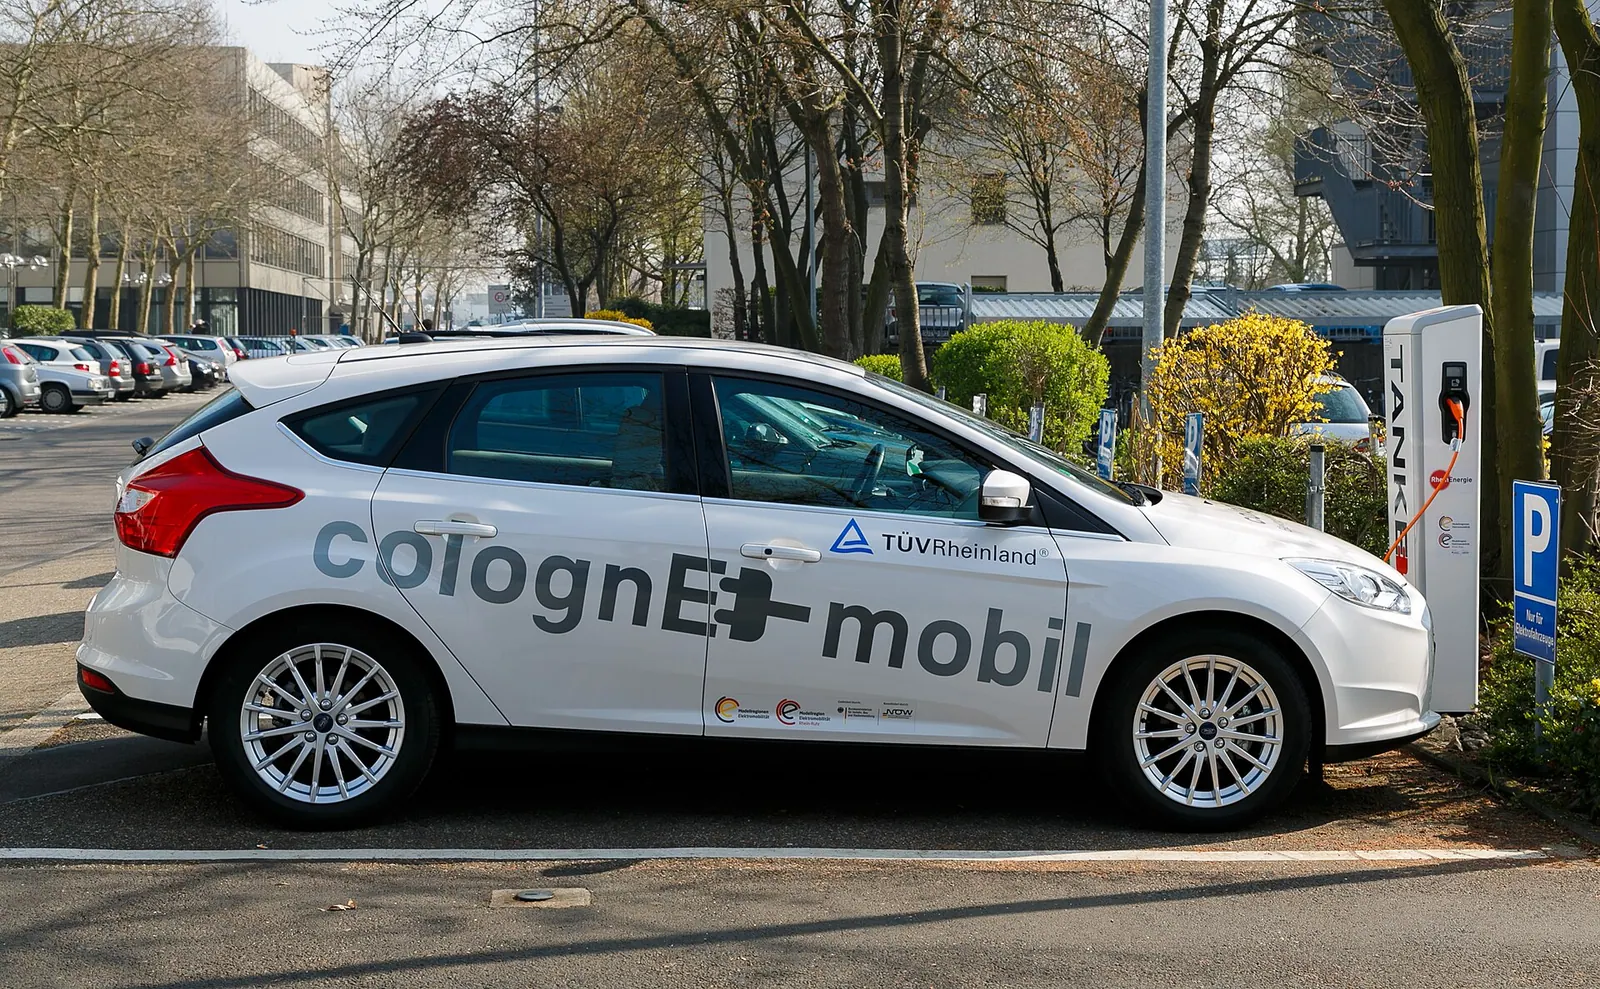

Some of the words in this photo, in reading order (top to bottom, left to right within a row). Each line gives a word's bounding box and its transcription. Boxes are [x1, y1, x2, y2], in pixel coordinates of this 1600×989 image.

[1390, 344, 1409, 576] TANKE
[1523, 492, 1551, 587] P
[313, 519, 727, 638] colognE
[821, 601, 1092, 698] mobil
[1516, 622, 1554, 647] Elektrofahrzeuge
[1526, 609, 1535, 622] Nur
[1535, 612, 1543, 625] für
